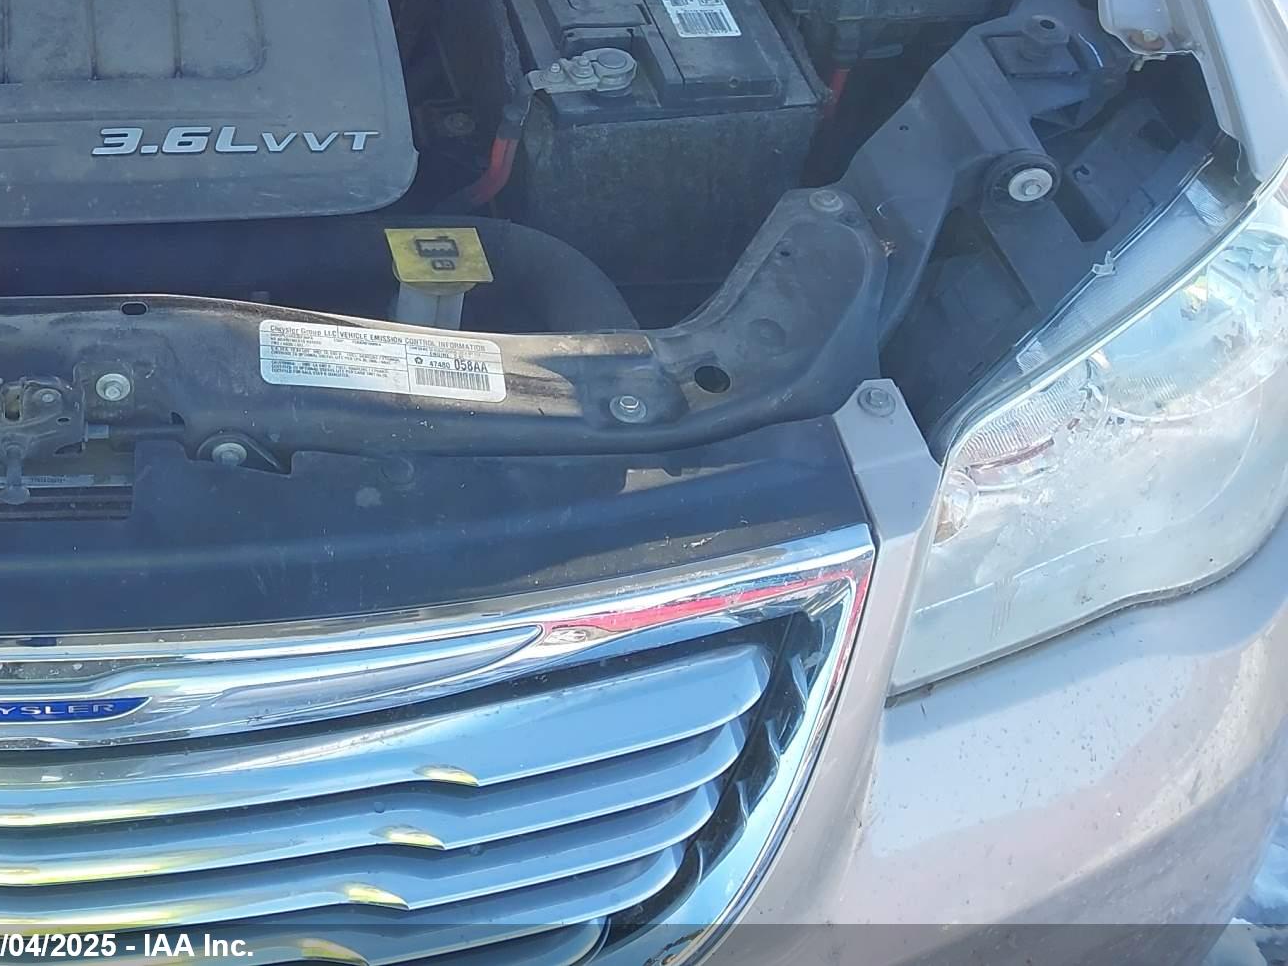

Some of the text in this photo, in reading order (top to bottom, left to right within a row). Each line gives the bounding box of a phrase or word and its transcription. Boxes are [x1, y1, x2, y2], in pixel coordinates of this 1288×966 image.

[270, 324, 337, 338] Chrysler Group LLC
[339, 330, 368, 340] VEHICLE
[369, 333, 403, 344] EMISSION
[405, 337, 436, 347] CONTROL
[438, 340, 486, 352] INFORMATION
[429, 358, 489, 372] 47480 058AA
